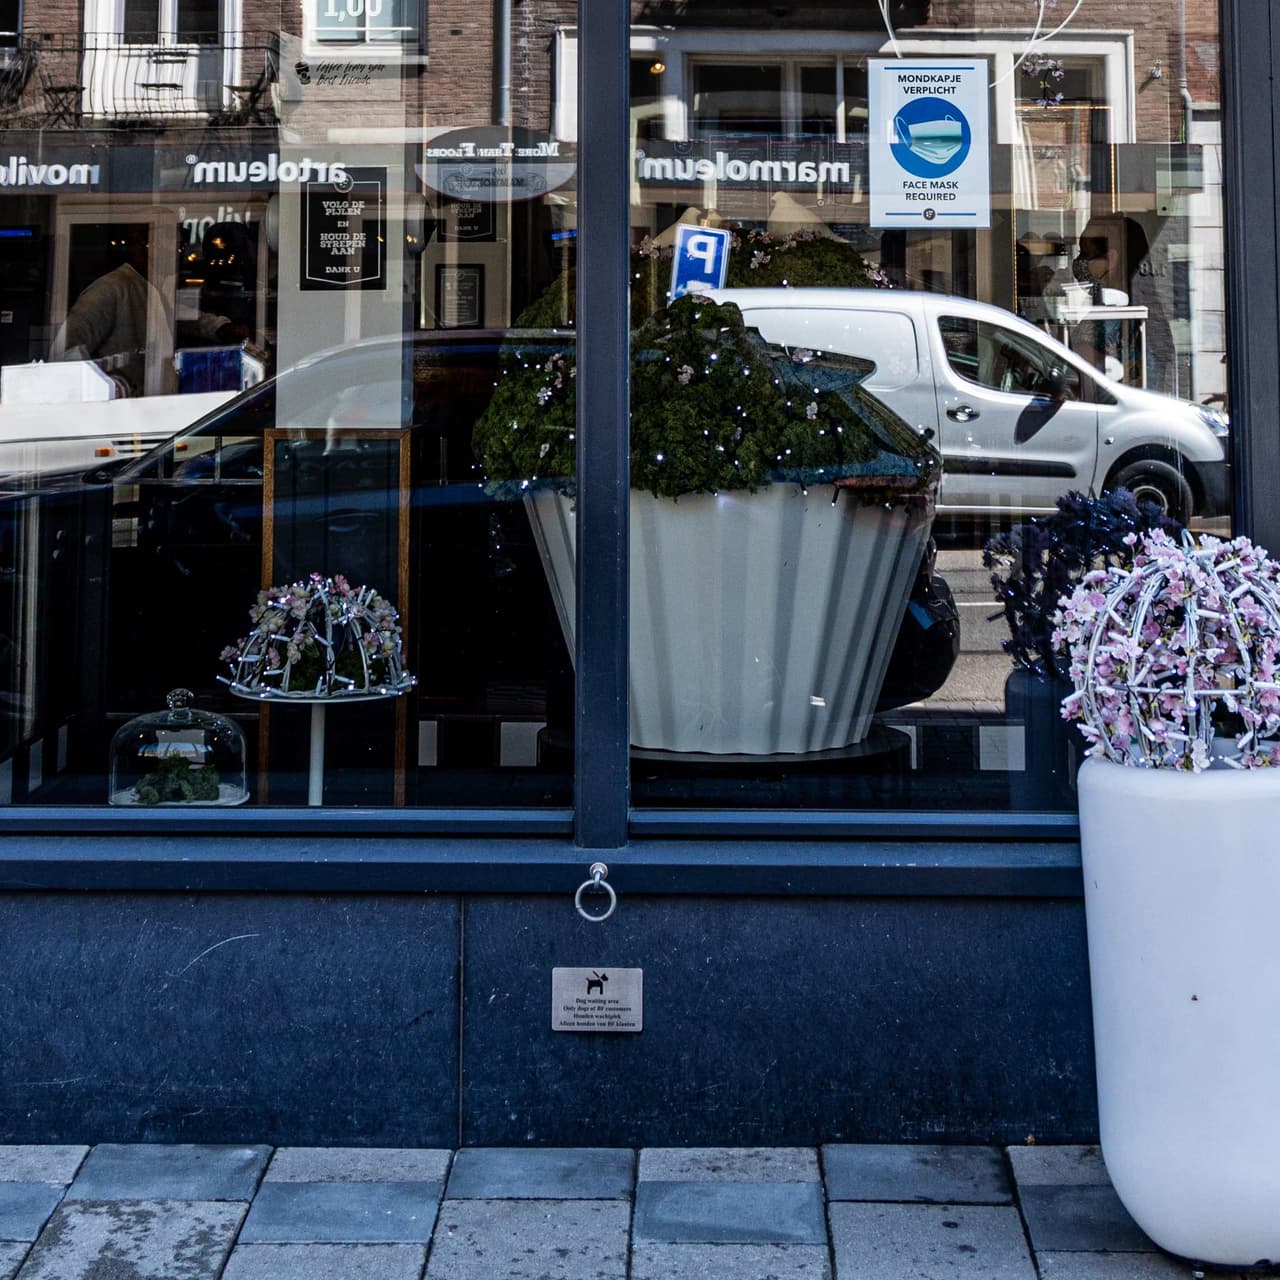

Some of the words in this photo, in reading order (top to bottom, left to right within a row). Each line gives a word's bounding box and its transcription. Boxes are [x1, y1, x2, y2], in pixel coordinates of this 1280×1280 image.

[898, 75, 961, 83] MONDKAPJE
[903, 86, 956, 94] VERPLICHT
[903, 181, 927, 189] FACE
[930, 181, 959, 189] MASK
[905, 193, 956, 201] REQUIRED
[322, 201, 350, 209] VOLG
[352, 201, 365, 209] DE
[320, 233, 350, 241] HOUD
[353, 233, 366, 241] DE
[320, 240, 366, 248] STREPEN
